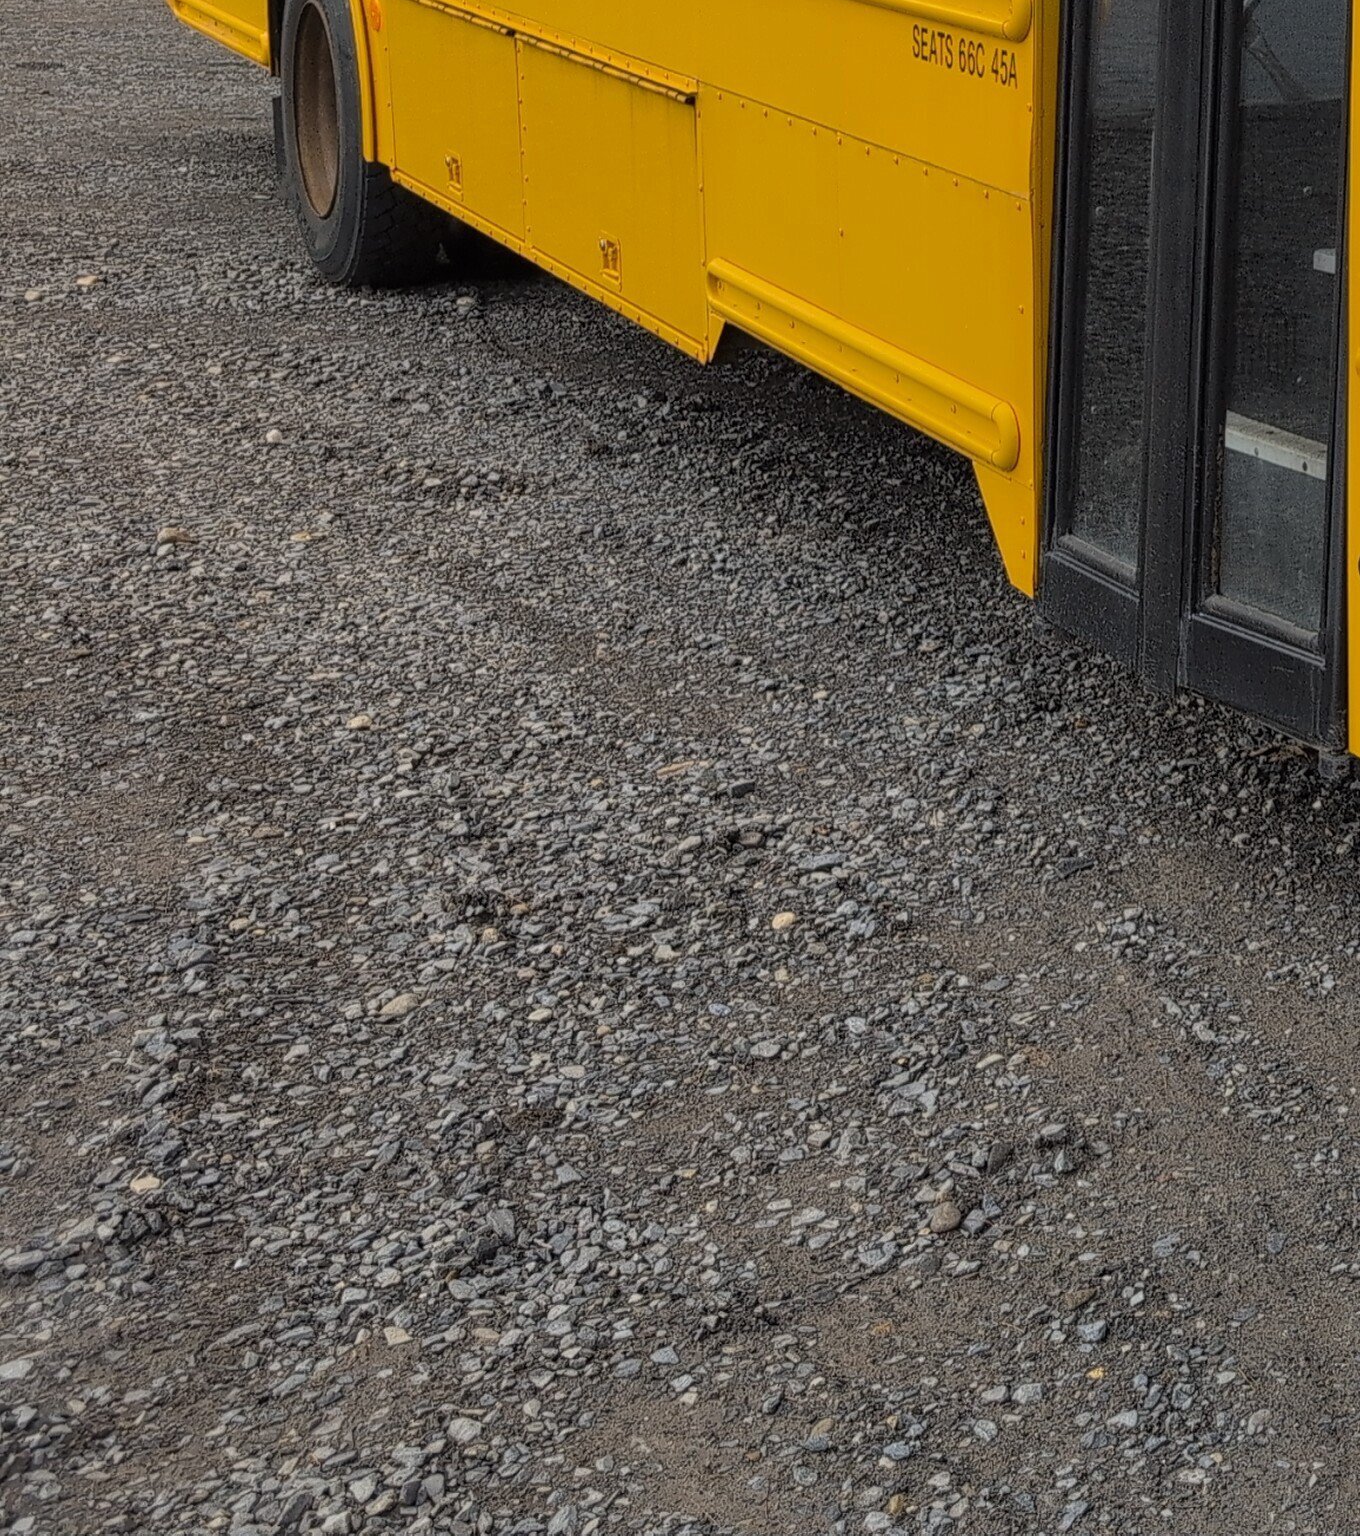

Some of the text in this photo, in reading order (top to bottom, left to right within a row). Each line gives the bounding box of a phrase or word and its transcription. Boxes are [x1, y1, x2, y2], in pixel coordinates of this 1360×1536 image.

[912, 24, 1018, 90] SEATS 66C 45A
